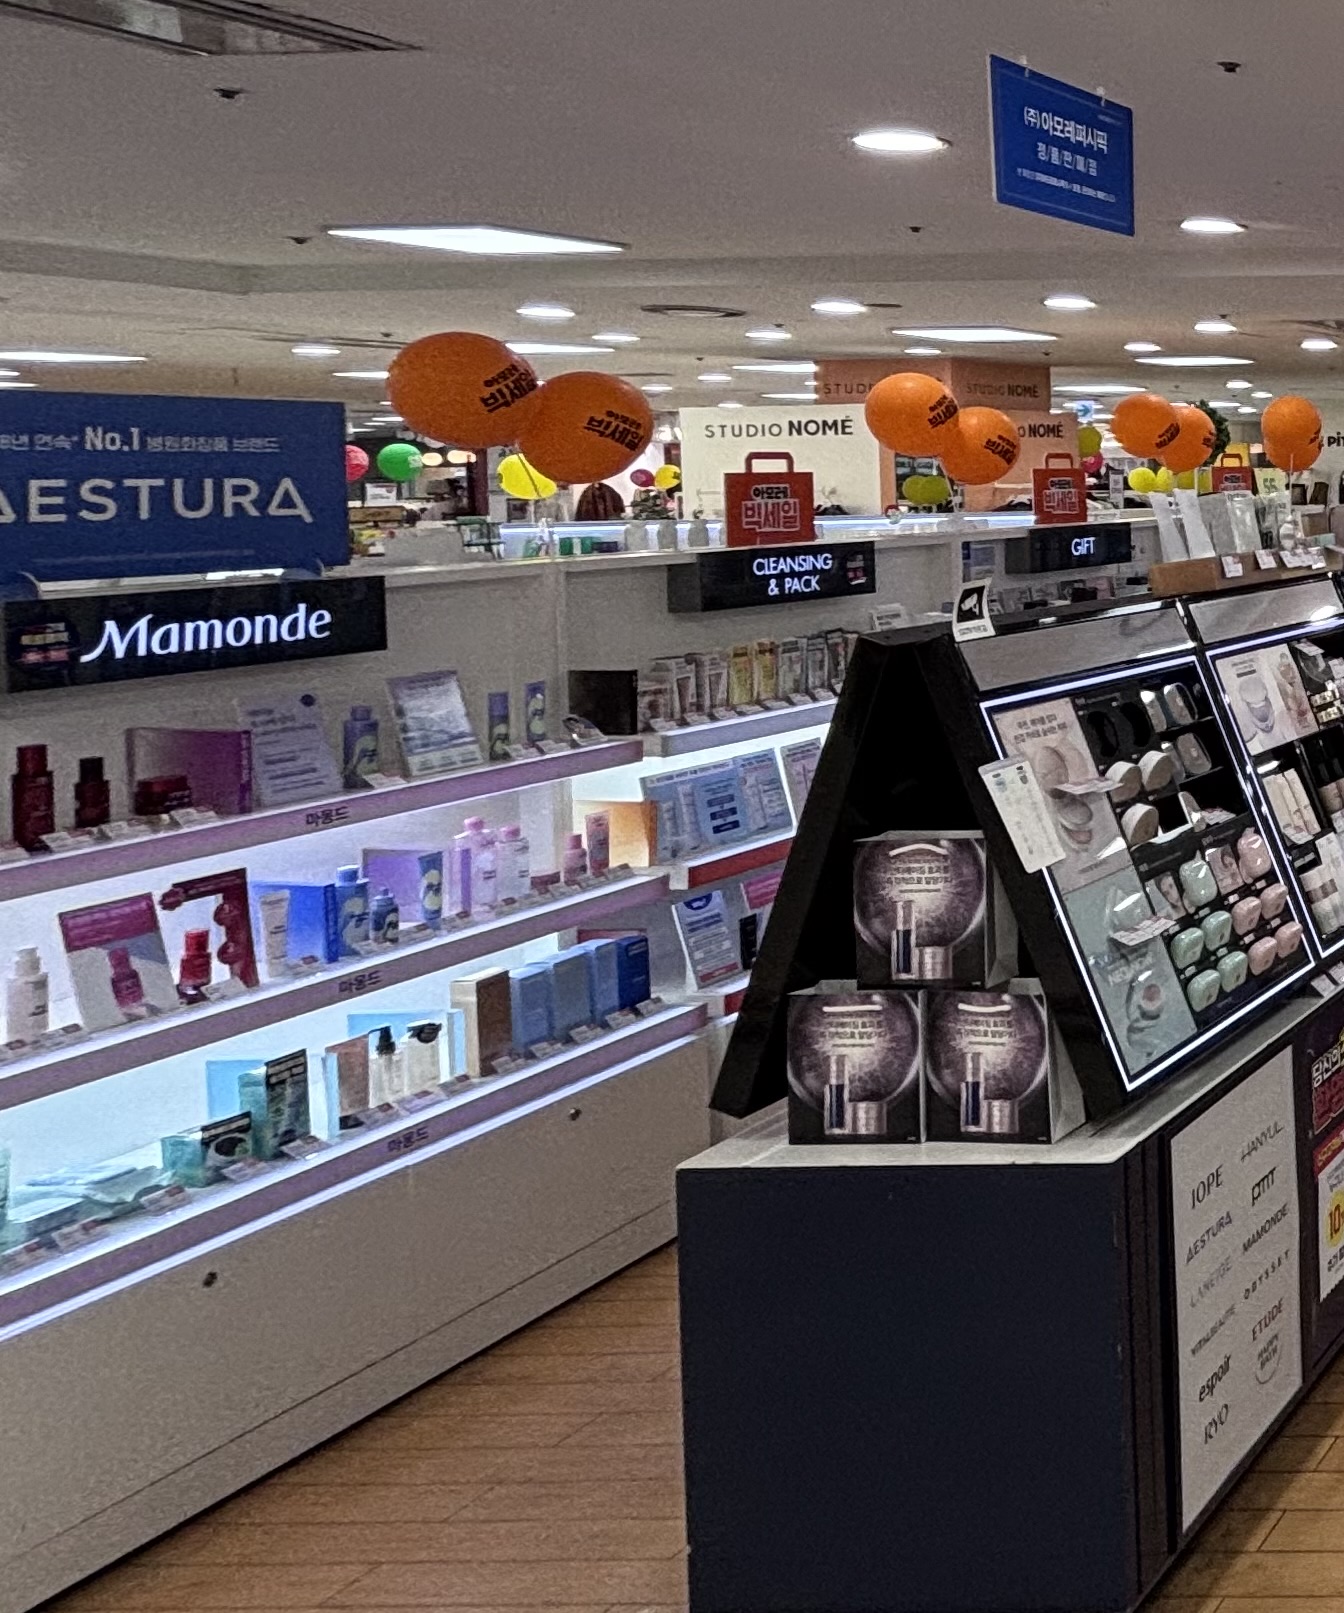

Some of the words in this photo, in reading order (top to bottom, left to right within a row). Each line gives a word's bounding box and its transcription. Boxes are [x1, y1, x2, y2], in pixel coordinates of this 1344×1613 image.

[85, 427, 140, 451] No.1
[583, 415, 645, 452] 빅세일
[704, 422, 782, 438] STUDIO
[788, 415, 854, 437] NOMÉ
[752, 486, 790, 500] 아모레
[742, 503, 799, 530] 빅세일
[752, 553, 833, 576] CLEANSING
[1071, 537, 1096, 557] GIFT
[767, 578, 780, 596] &
[784, 574, 821, 594] PACK
[80, 603, 333, 664] Mamonde
[305, 805, 349, 827] 마몽드
[1240, 1121, 1285, 1163] HANYUL
[1191, 1164, 1223, 1210] IOPE
[1186, 1211, 1233, 1264] AESTURA
[1242, 1203, 1289, 1256] MAMONDE
[1252, 1296, 1284, 1342] ETUDE
[1199, 1353, 1232, 1403] espoir
[1204, 1402, 1229, 1446] RYO
